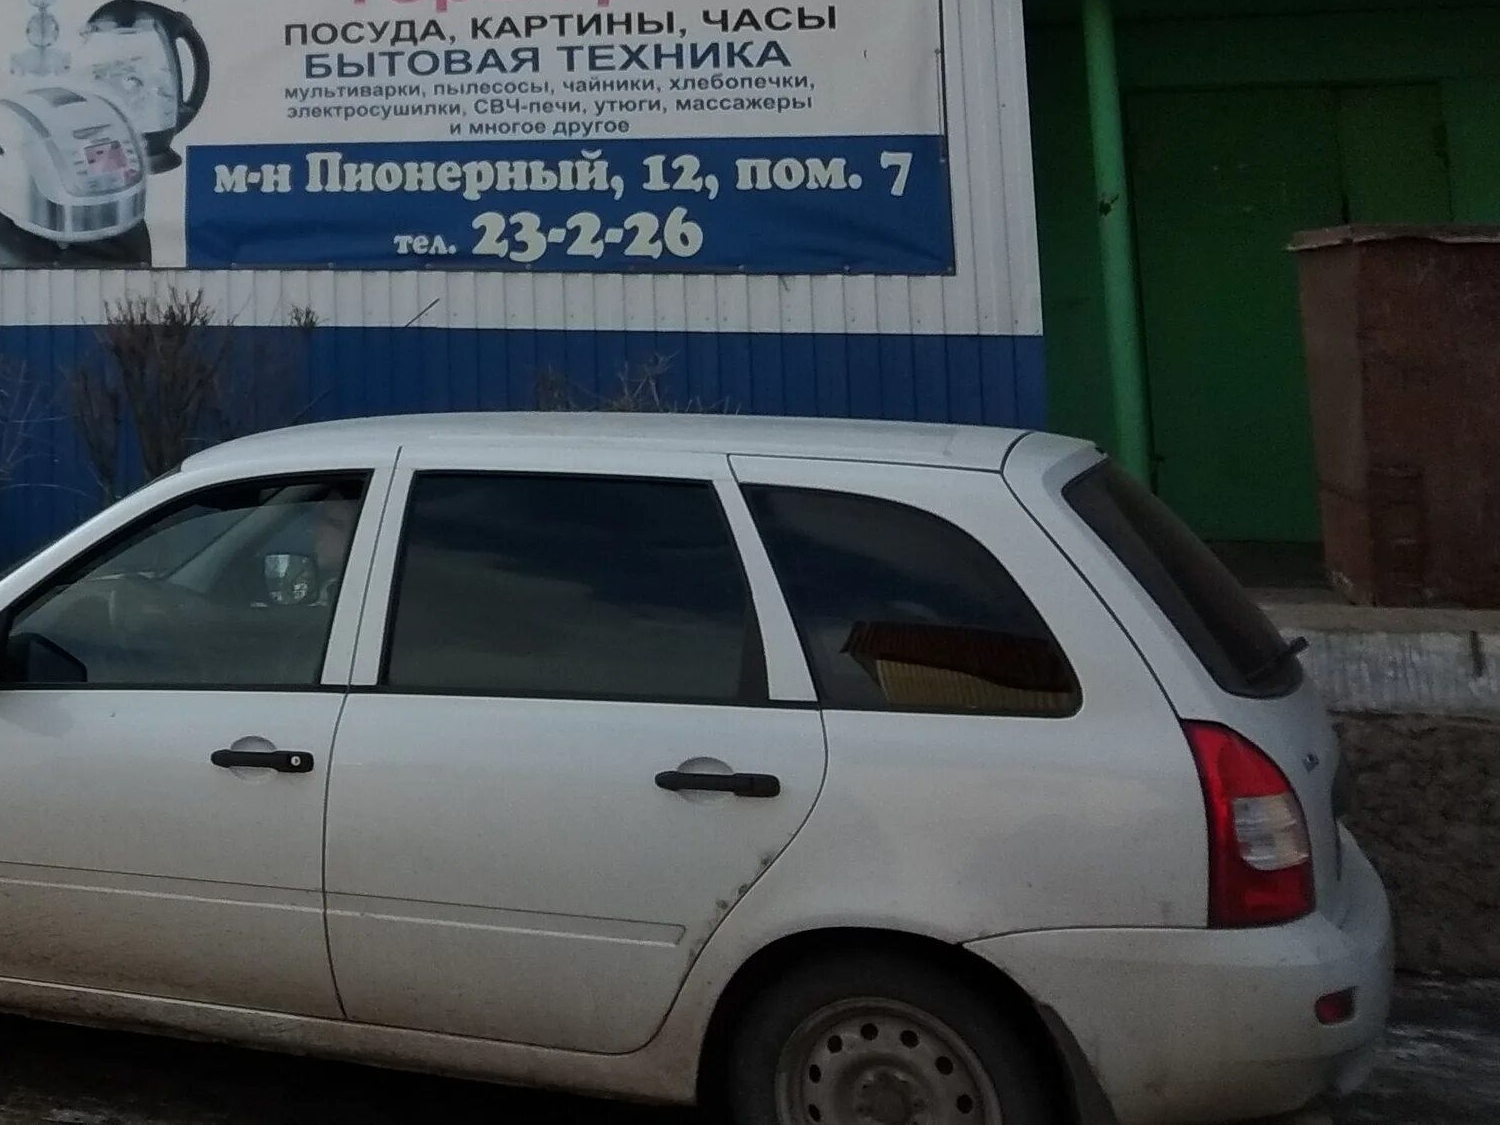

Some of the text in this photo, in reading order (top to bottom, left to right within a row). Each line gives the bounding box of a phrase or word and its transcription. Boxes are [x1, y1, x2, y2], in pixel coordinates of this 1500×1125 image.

[284, 5, 836, 47] ПОСУДА, КАРТИНЫ, ЧАСЫ
[305, 40, 792, 80] БЫТОВАЯ ТЕХНИКА
[284, 74, 816, 101] мультиварки, пылесосы, чайники, хлебопечки,
[287, 95, 813, 121] электросушилки, СВЧ-печи, утюги, массажеры
[449, 119, 630, 138] и многое другое
[214, 149, 913, 201] м-н Пионерный, 12, пом. 7
[393, 206, 704, 263] тел. 23-2-26
